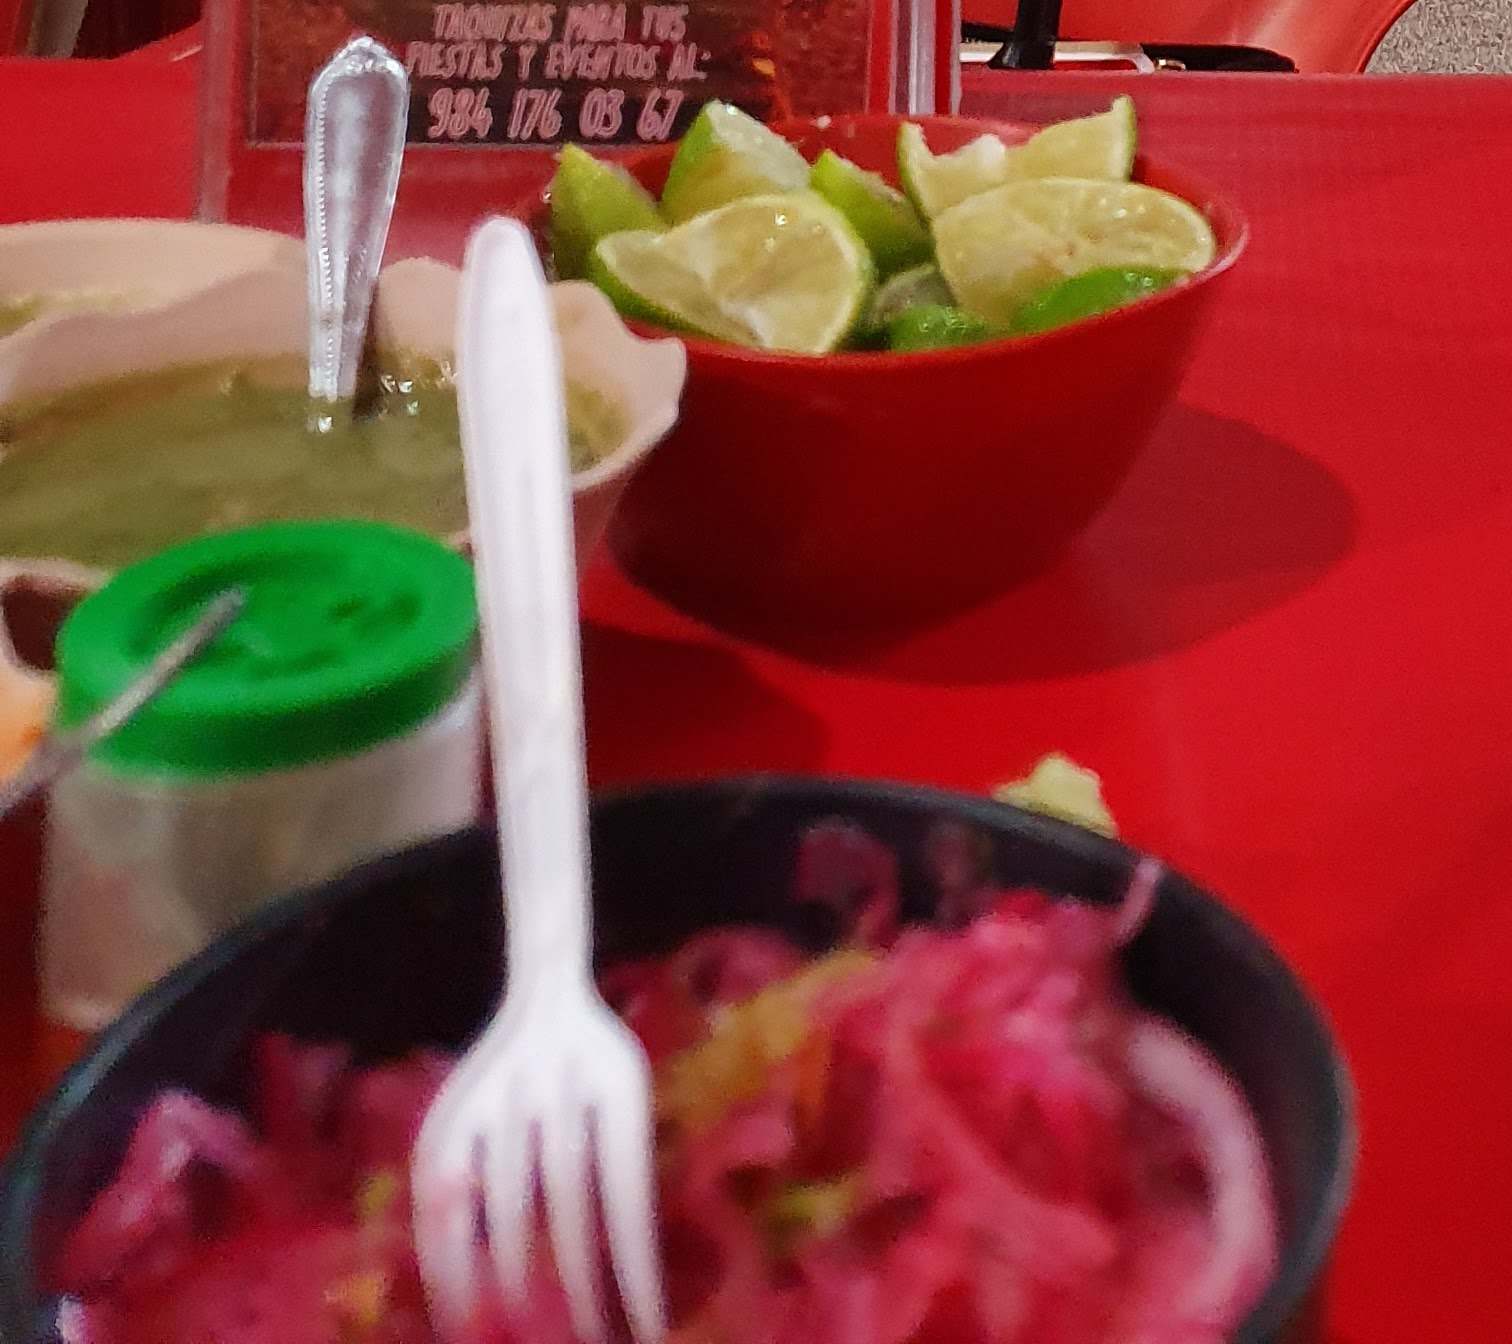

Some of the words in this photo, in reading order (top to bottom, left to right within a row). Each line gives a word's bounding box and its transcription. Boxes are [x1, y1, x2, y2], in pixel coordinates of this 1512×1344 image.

[518, 42, 538, 81] Y
[545, 40, 661, 81] EVENTOS
[427, 86, 493, 139] 984
[507, 86, 564, 140] 176
[578, 87, 626, 140] 03
[636, 87, 685, 141] 67
